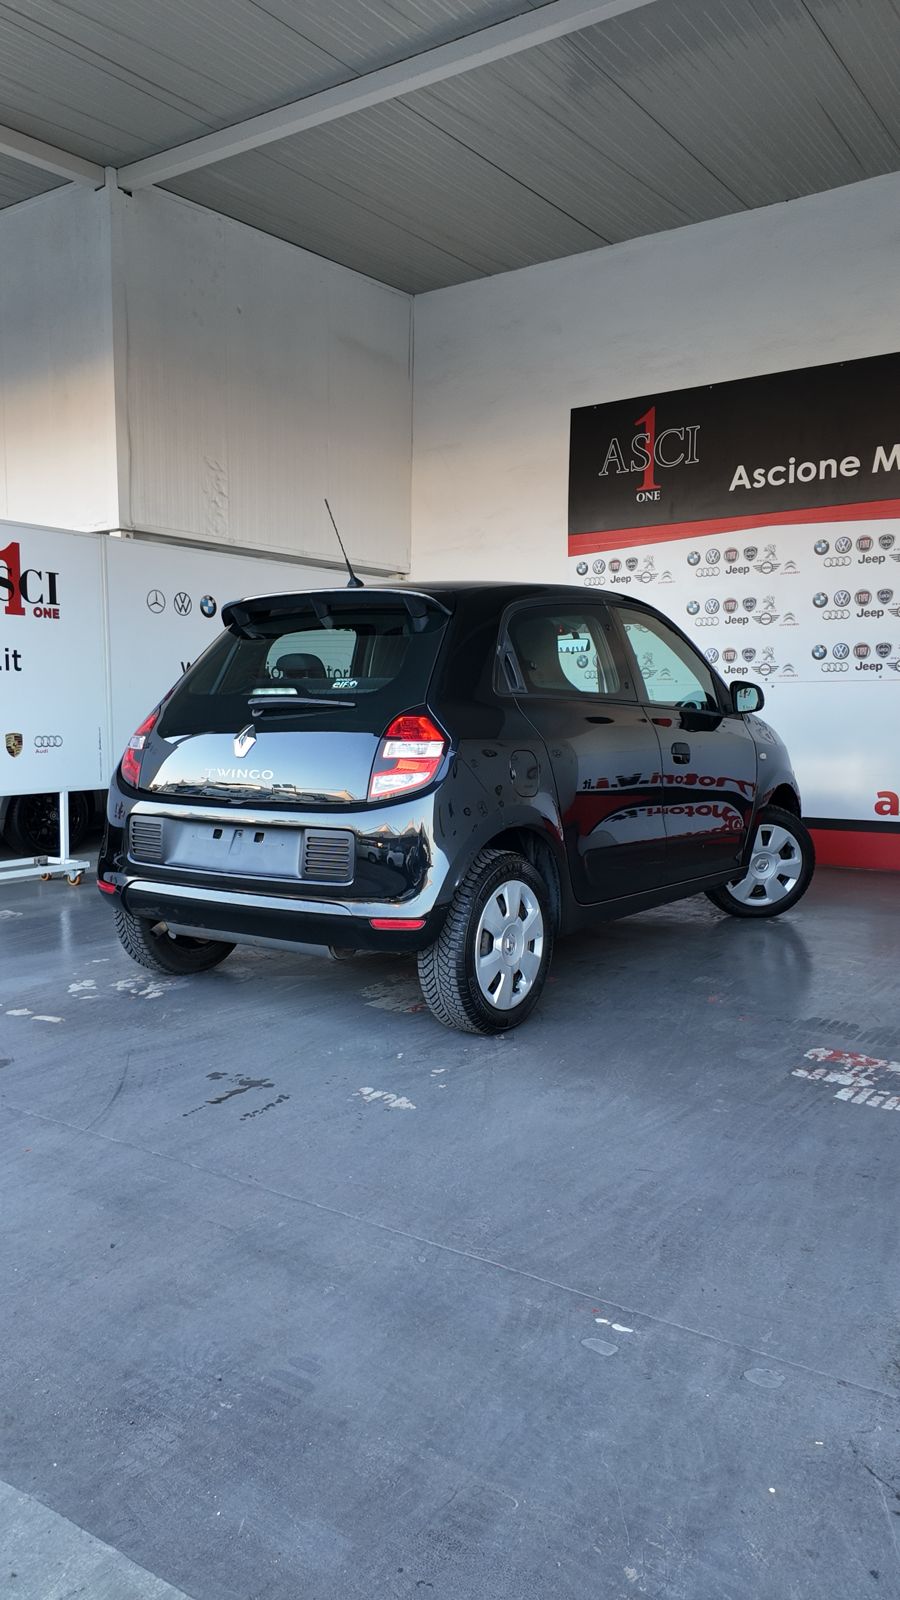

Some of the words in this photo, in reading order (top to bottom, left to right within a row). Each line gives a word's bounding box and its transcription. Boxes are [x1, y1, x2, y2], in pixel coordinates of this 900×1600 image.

[598, 425, 701, 477] ASCI
[729, 456, 861, 492] Ascione
[636, 490, 661, 504] ONE
[858, 554, 886, 565] Jeep
[725, 565, 750, 575] Jeep
[610, 575, 632, 584] Jeep
[33, 606, 61, 620] ONE
[857, 608, 884, 619] Jeep
[724, 615, 749, 626] Jeep
[724, 665, 749, 675] Jeep
[855, 661, 883, 672] Jeep
[204, 768, 274, 780] TWINGO
